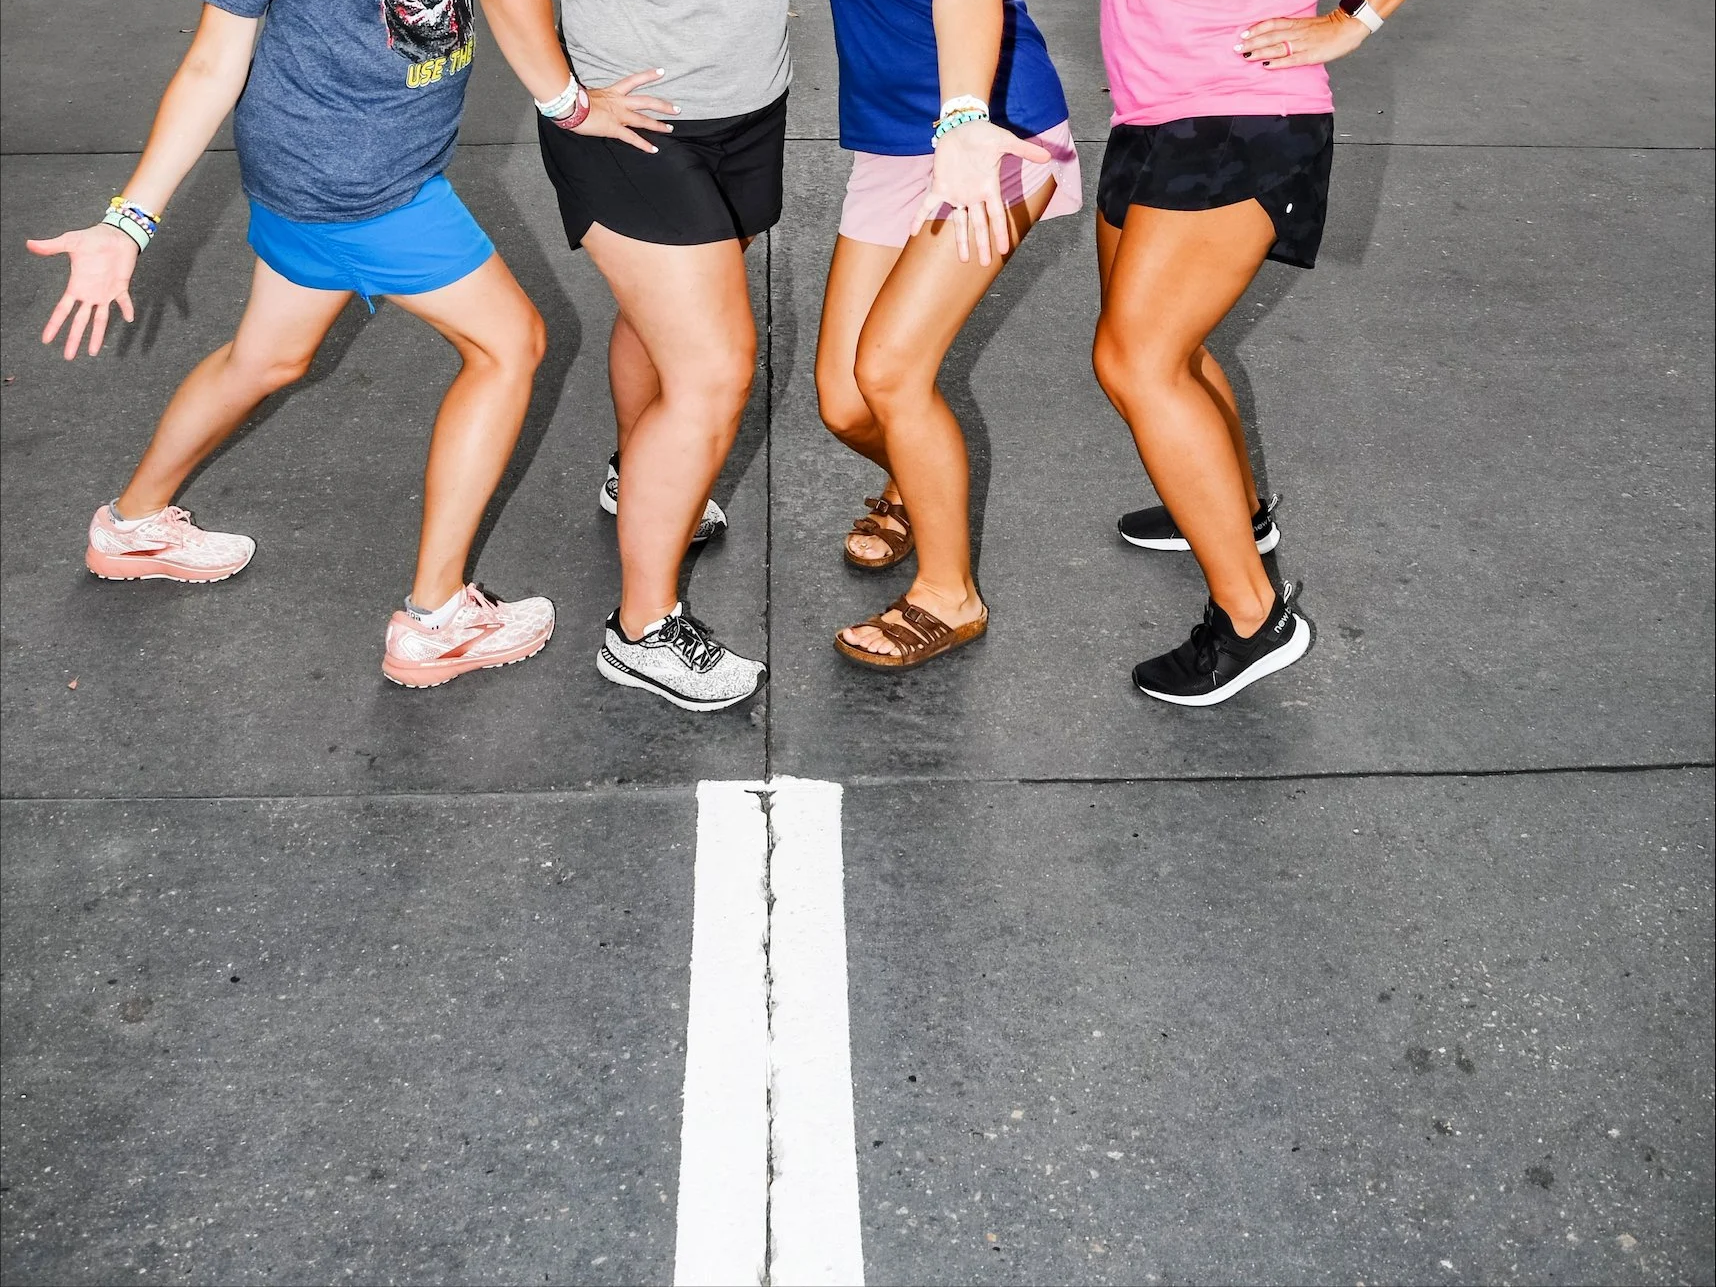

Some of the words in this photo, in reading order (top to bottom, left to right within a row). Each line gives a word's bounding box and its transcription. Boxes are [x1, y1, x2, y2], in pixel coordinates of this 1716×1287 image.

[407, 57, 447, 88] USE
[450, 36, 475, 75] THE
[1273, 612, 1289, 634] new
